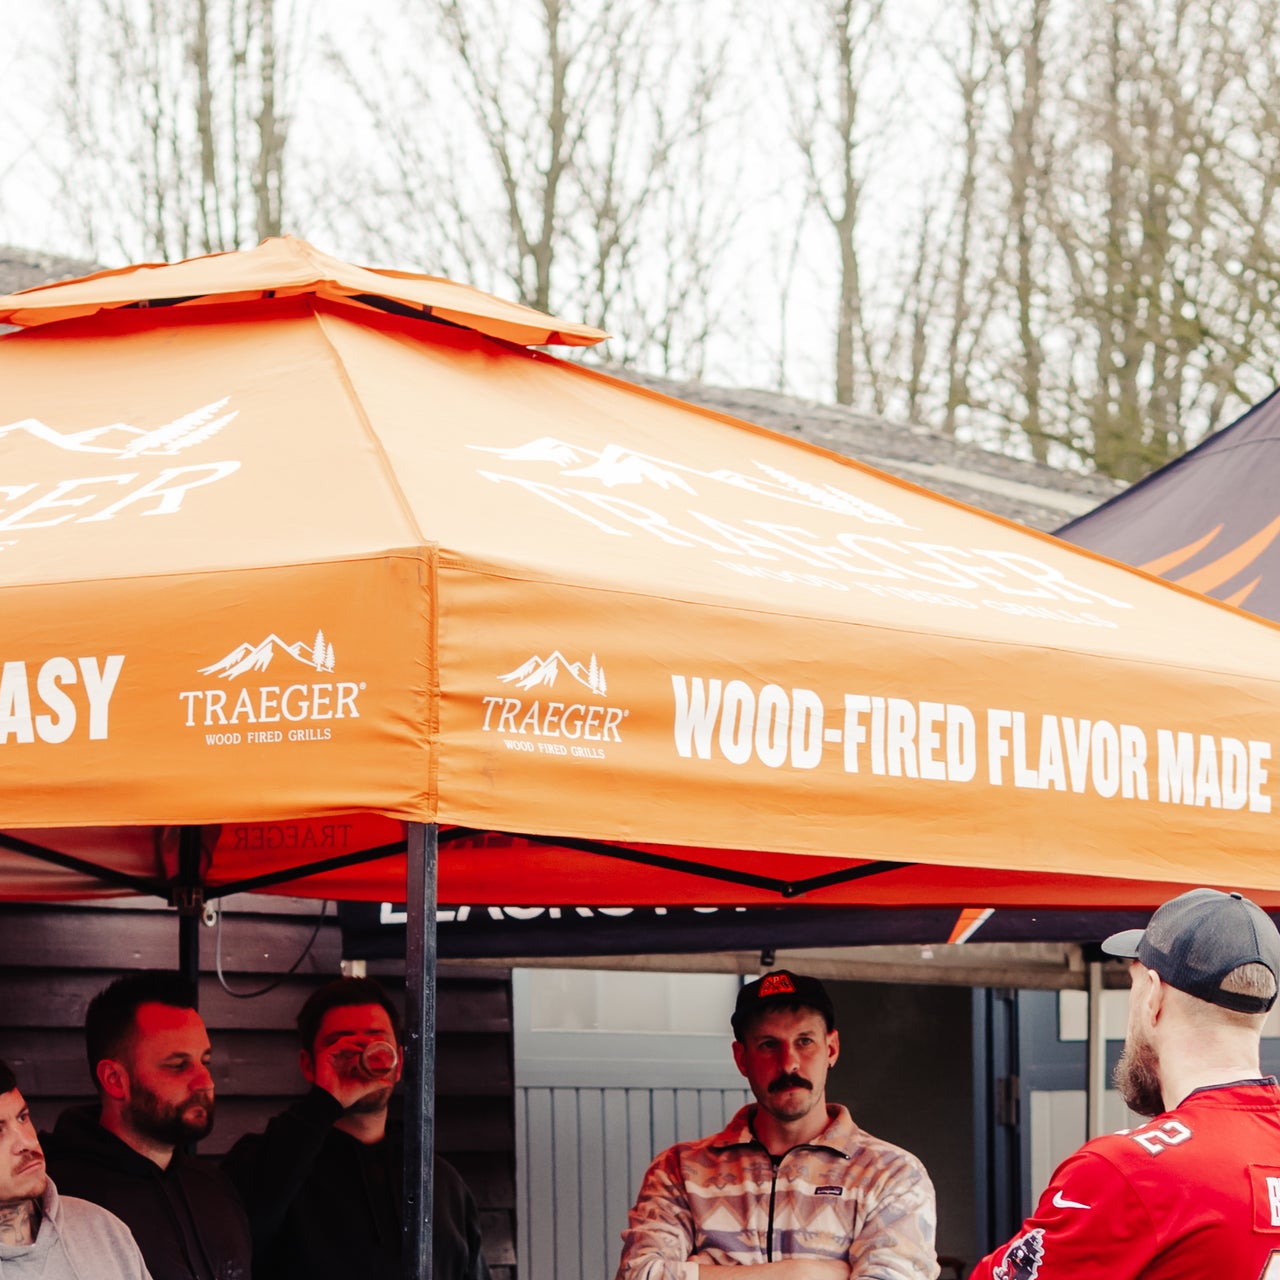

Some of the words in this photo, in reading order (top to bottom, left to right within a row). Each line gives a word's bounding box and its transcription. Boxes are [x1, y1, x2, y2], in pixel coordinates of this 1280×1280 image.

[179, 682, 360, 726] TRAEGER
[482, 696, 623, 742] TRAEGER
[205, 733, 241, 746] WOOD
[247, 731, 283, 744] FIRED
[288, 728, 332, 742] GRILLS
[504, 739, 535, 752] WOOD
[538, 743, 568, 756] FIRED
[571, 746, 605, 760] GRILLS
[671, 675, 976, 783] WOOD-FIRED
[987, 708, 1149, 800] FLAVOR
[1157, 728, 1272, 814] MADE
